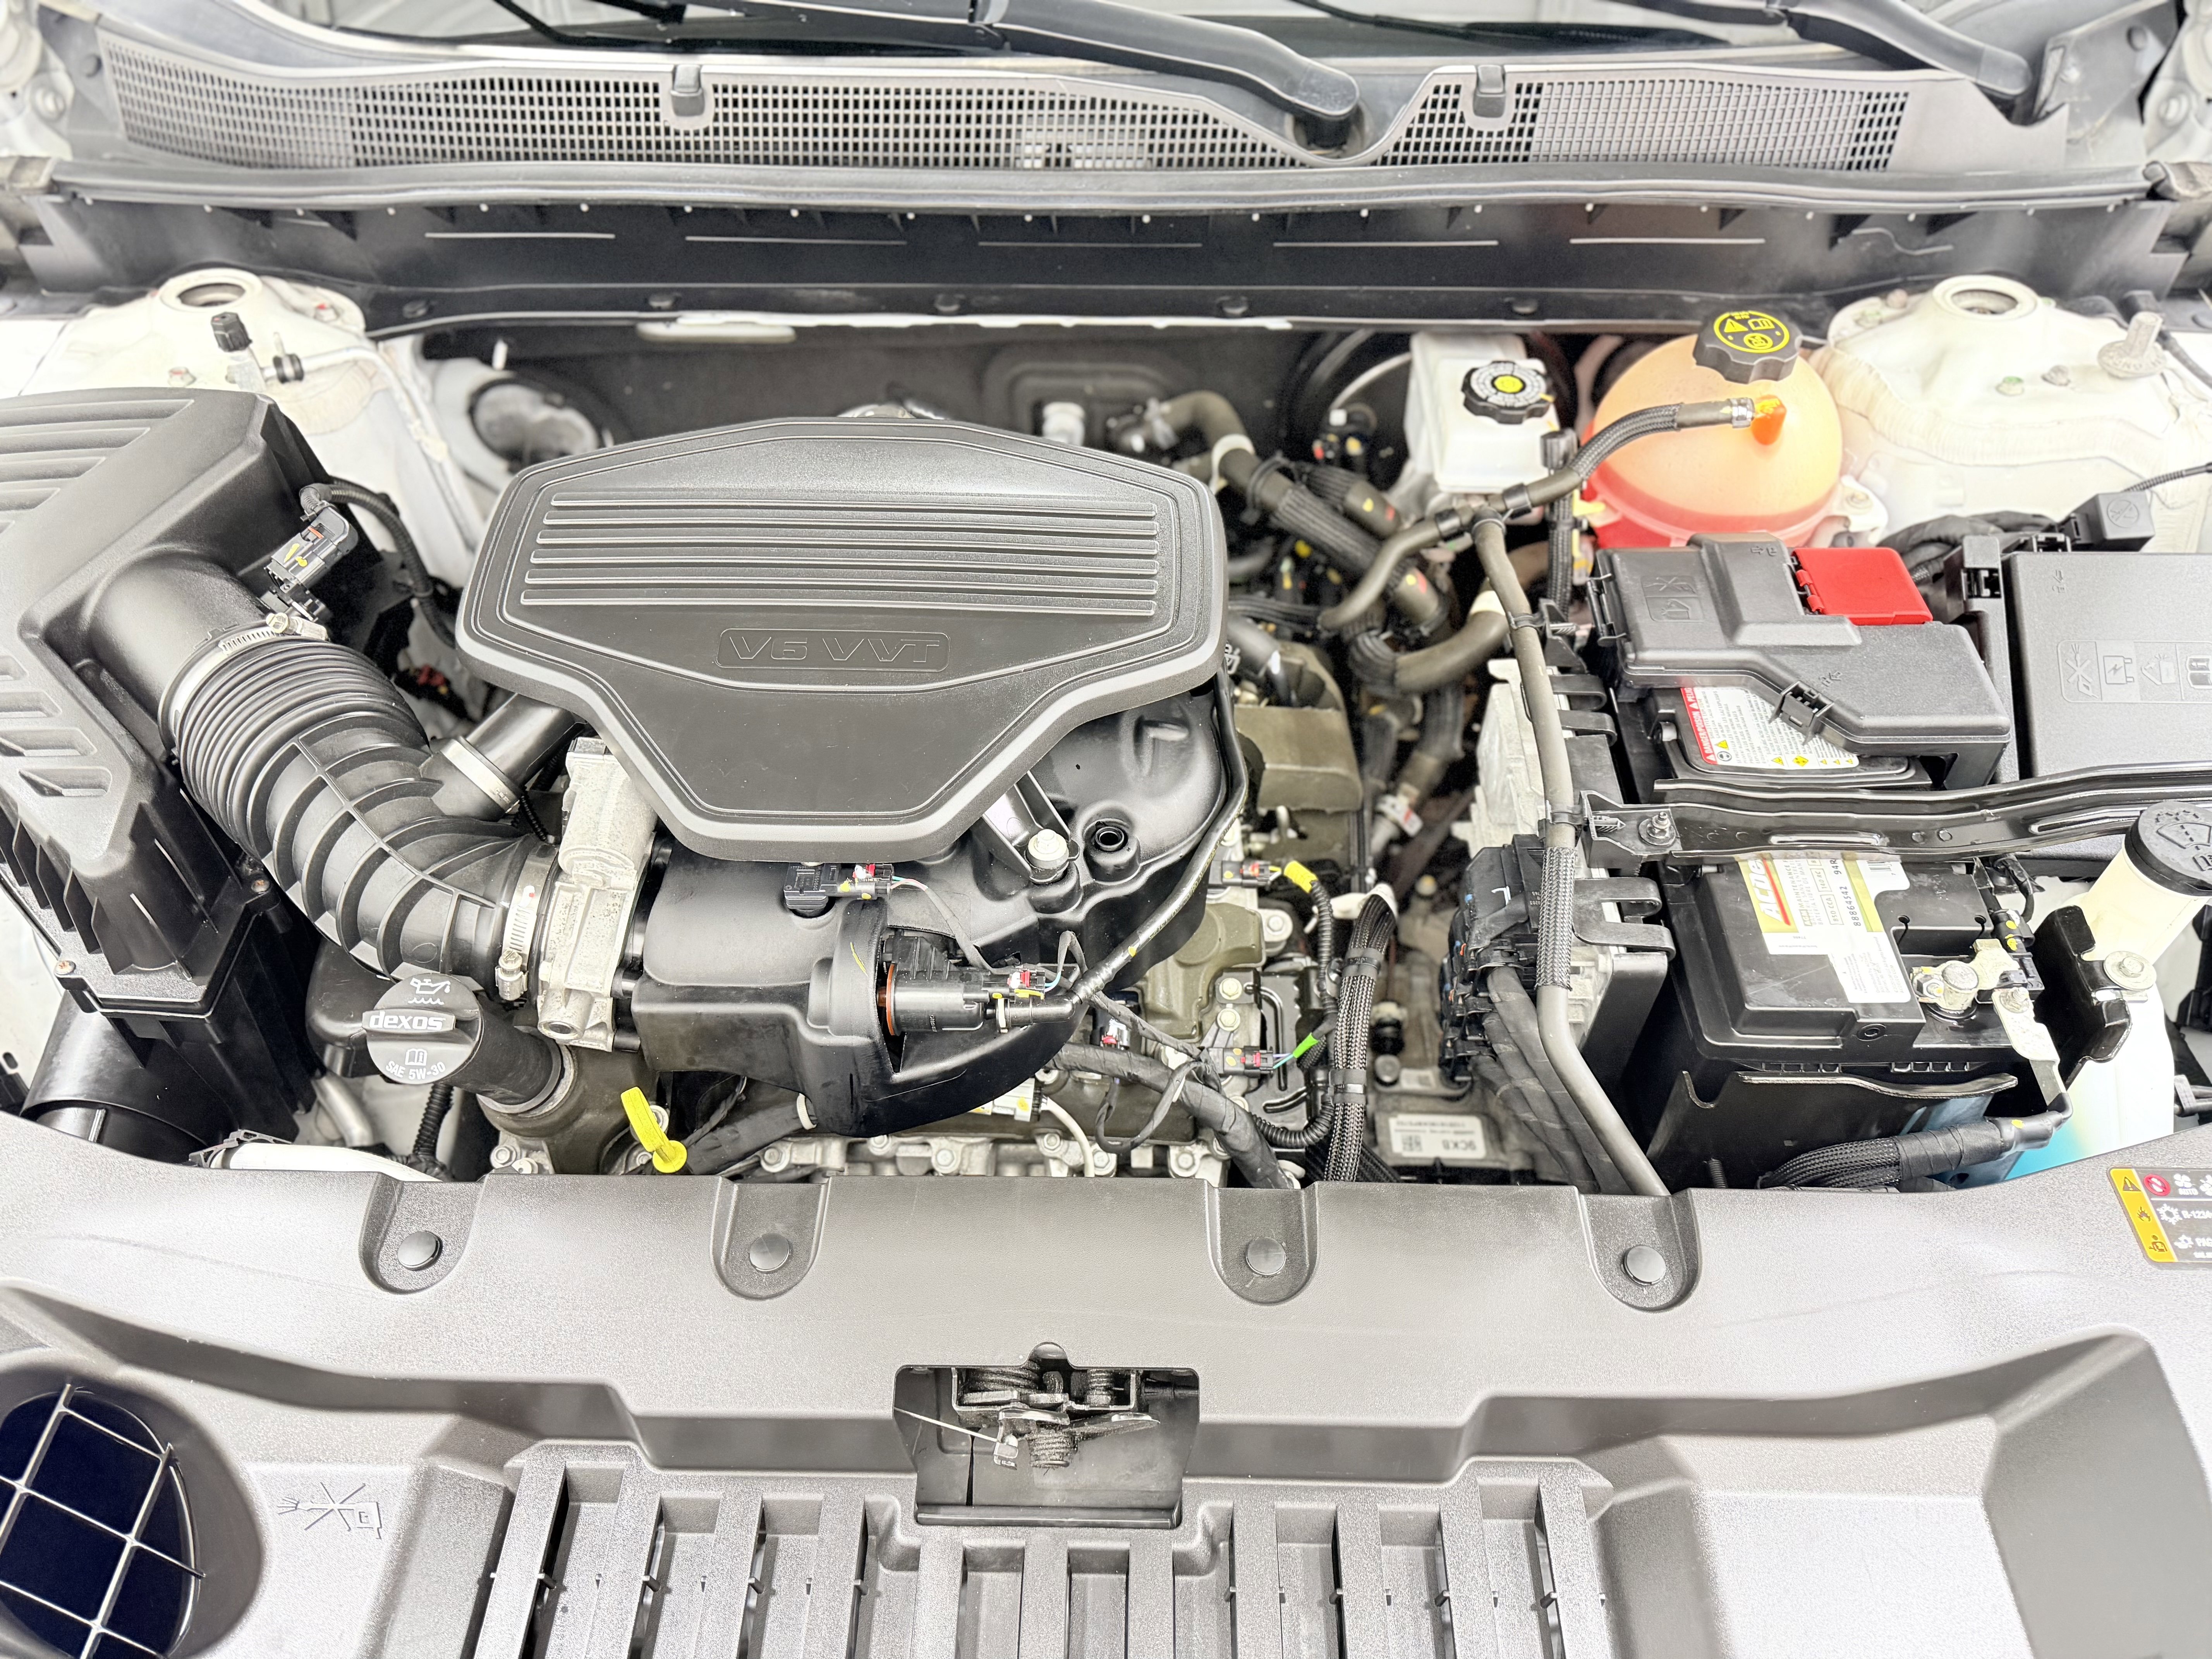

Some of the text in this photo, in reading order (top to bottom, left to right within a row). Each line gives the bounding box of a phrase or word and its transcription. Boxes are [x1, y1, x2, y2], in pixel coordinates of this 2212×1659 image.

[729, 636, 940, 663] V6 VVT
[1692, 711, 1713, 753] DANGER/POISON
[1785, 865, 1804, 908] MAINTENANCE
[1800, 884, 1808, 897] SANS
[1826, 897, 1839, 921] 850 CCA
[1839, 886, 1861, 926] 88864542
[369, 1012, 443, 1031] dexos
[385, 1060, 446, 1080] SAE 5W-30
